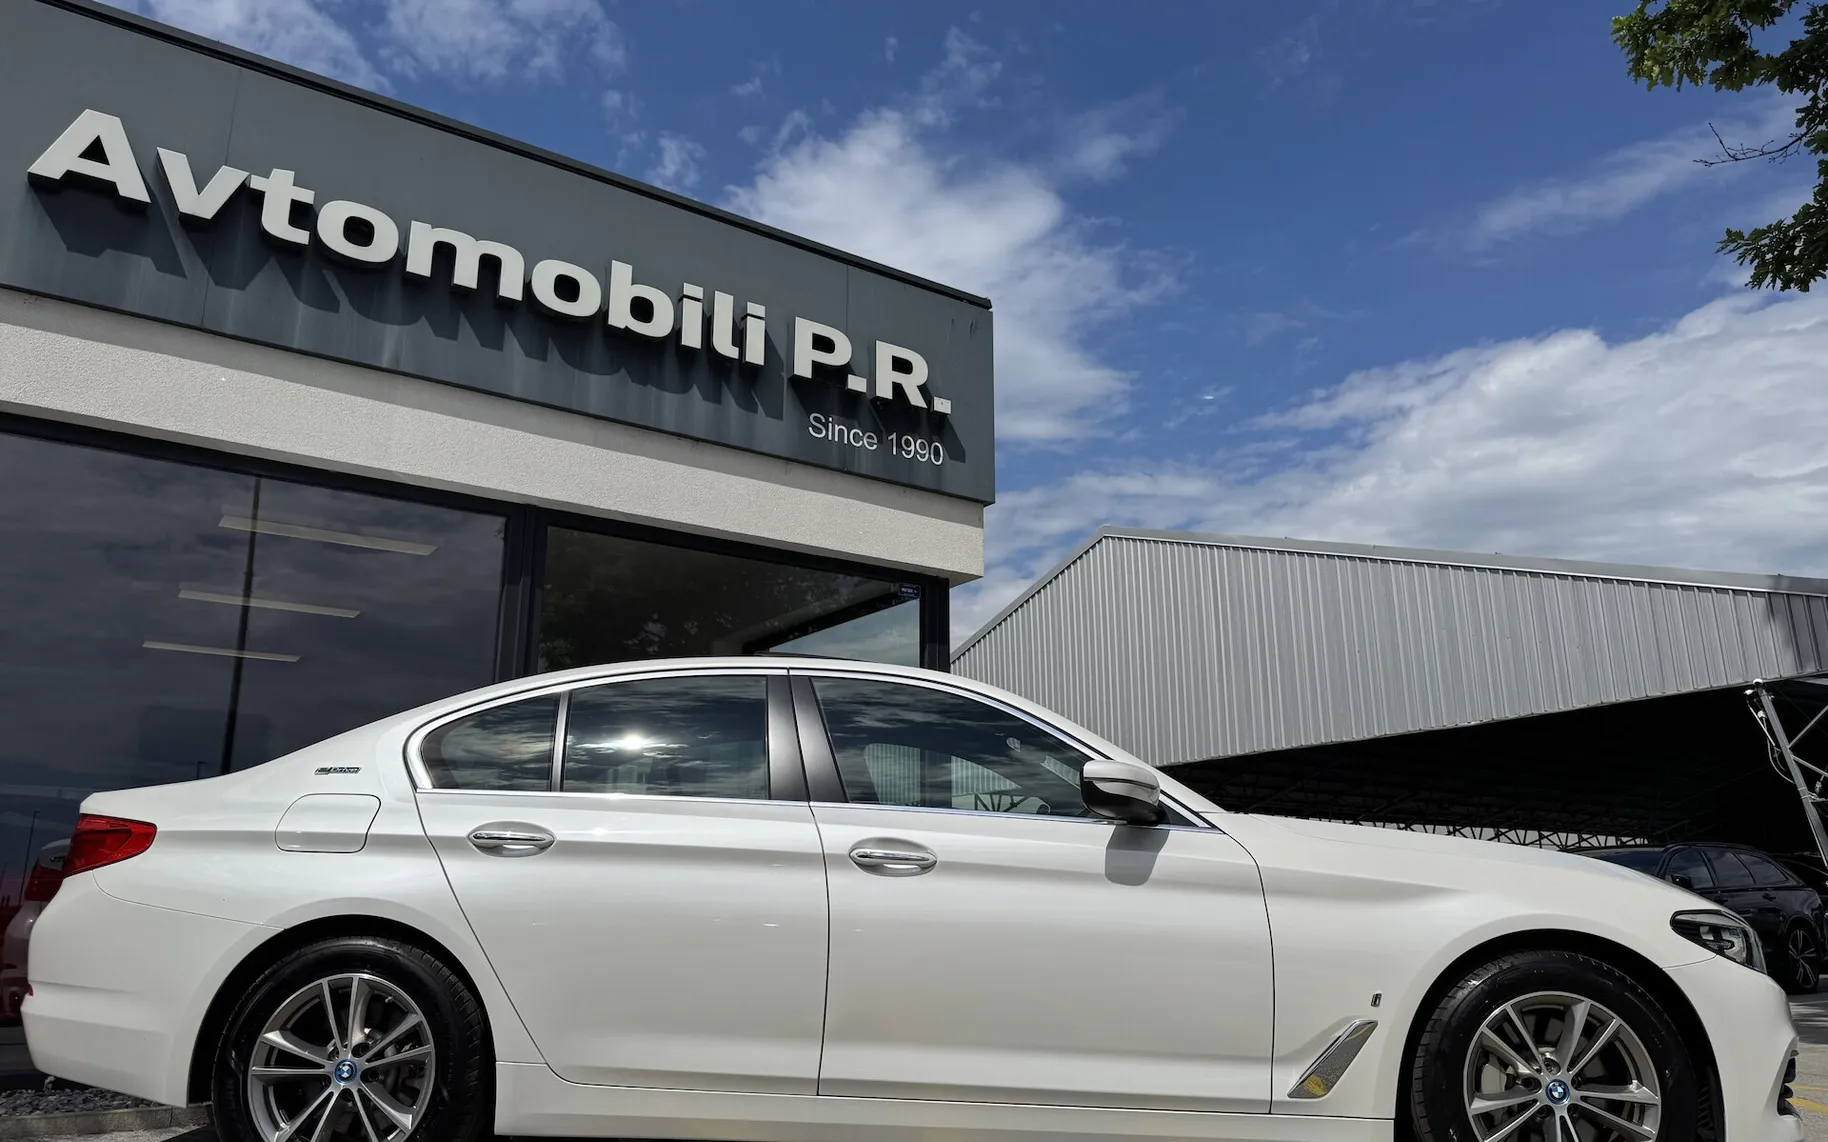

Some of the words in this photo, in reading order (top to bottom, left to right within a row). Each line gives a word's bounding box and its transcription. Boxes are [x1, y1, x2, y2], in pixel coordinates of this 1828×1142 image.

[28, 108, 766, 366] Avtomobili
[793, 316, 952, 415] P.R.
[808, 412, 878, 451] Since
[887, 432, 944, 466] 1990
